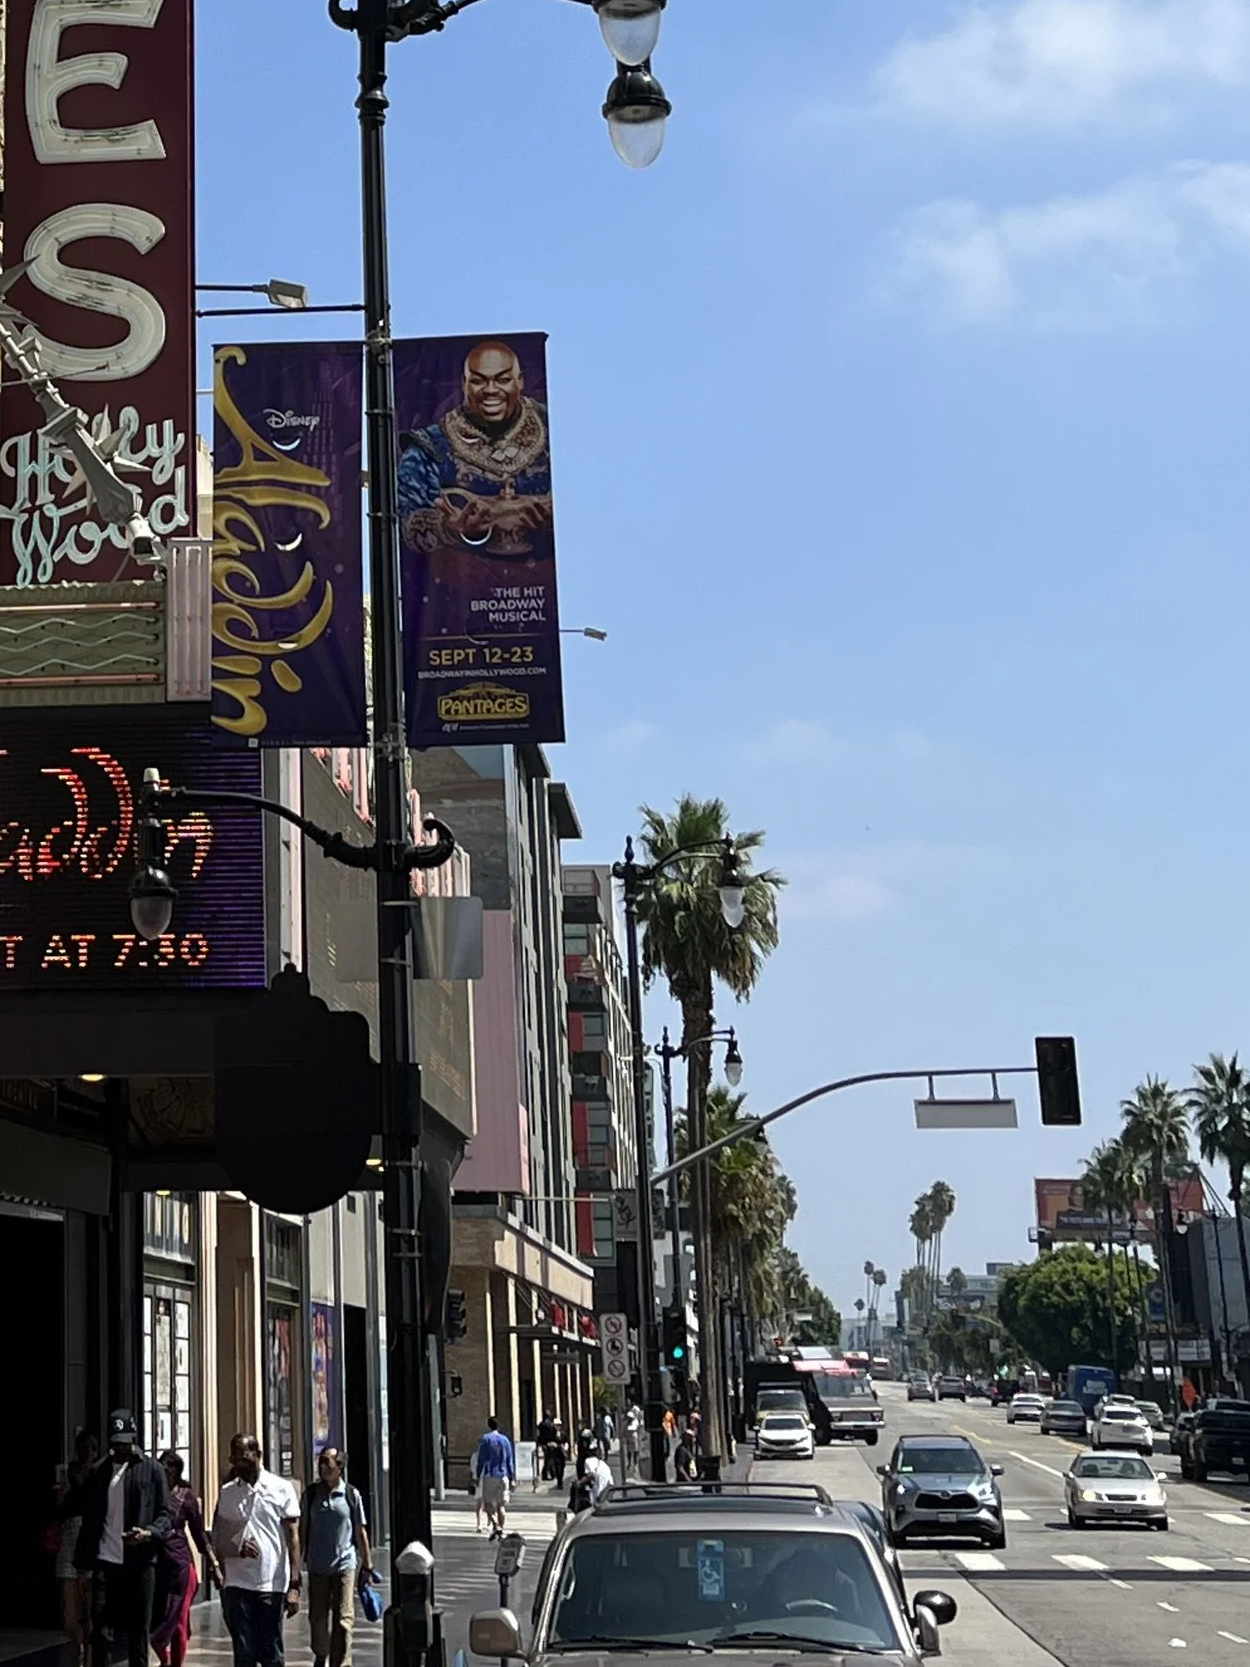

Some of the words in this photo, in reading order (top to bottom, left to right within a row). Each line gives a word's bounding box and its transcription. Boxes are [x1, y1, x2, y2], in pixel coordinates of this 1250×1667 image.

[496, 587, 521, 598] THE
[524, 586, 545, 598] HIT
[470, 598, 546, 612] BROADWAY
[488, 611, 547, 623] MUSICAL
[429, 648, 477, 666] SEPT
[482, 646, 534, 664] 12-23
[441, 696, 528, 715] PANTAGES
[41, 934, 95, 969] AT
[112, 934, 210, 968] 7:30
